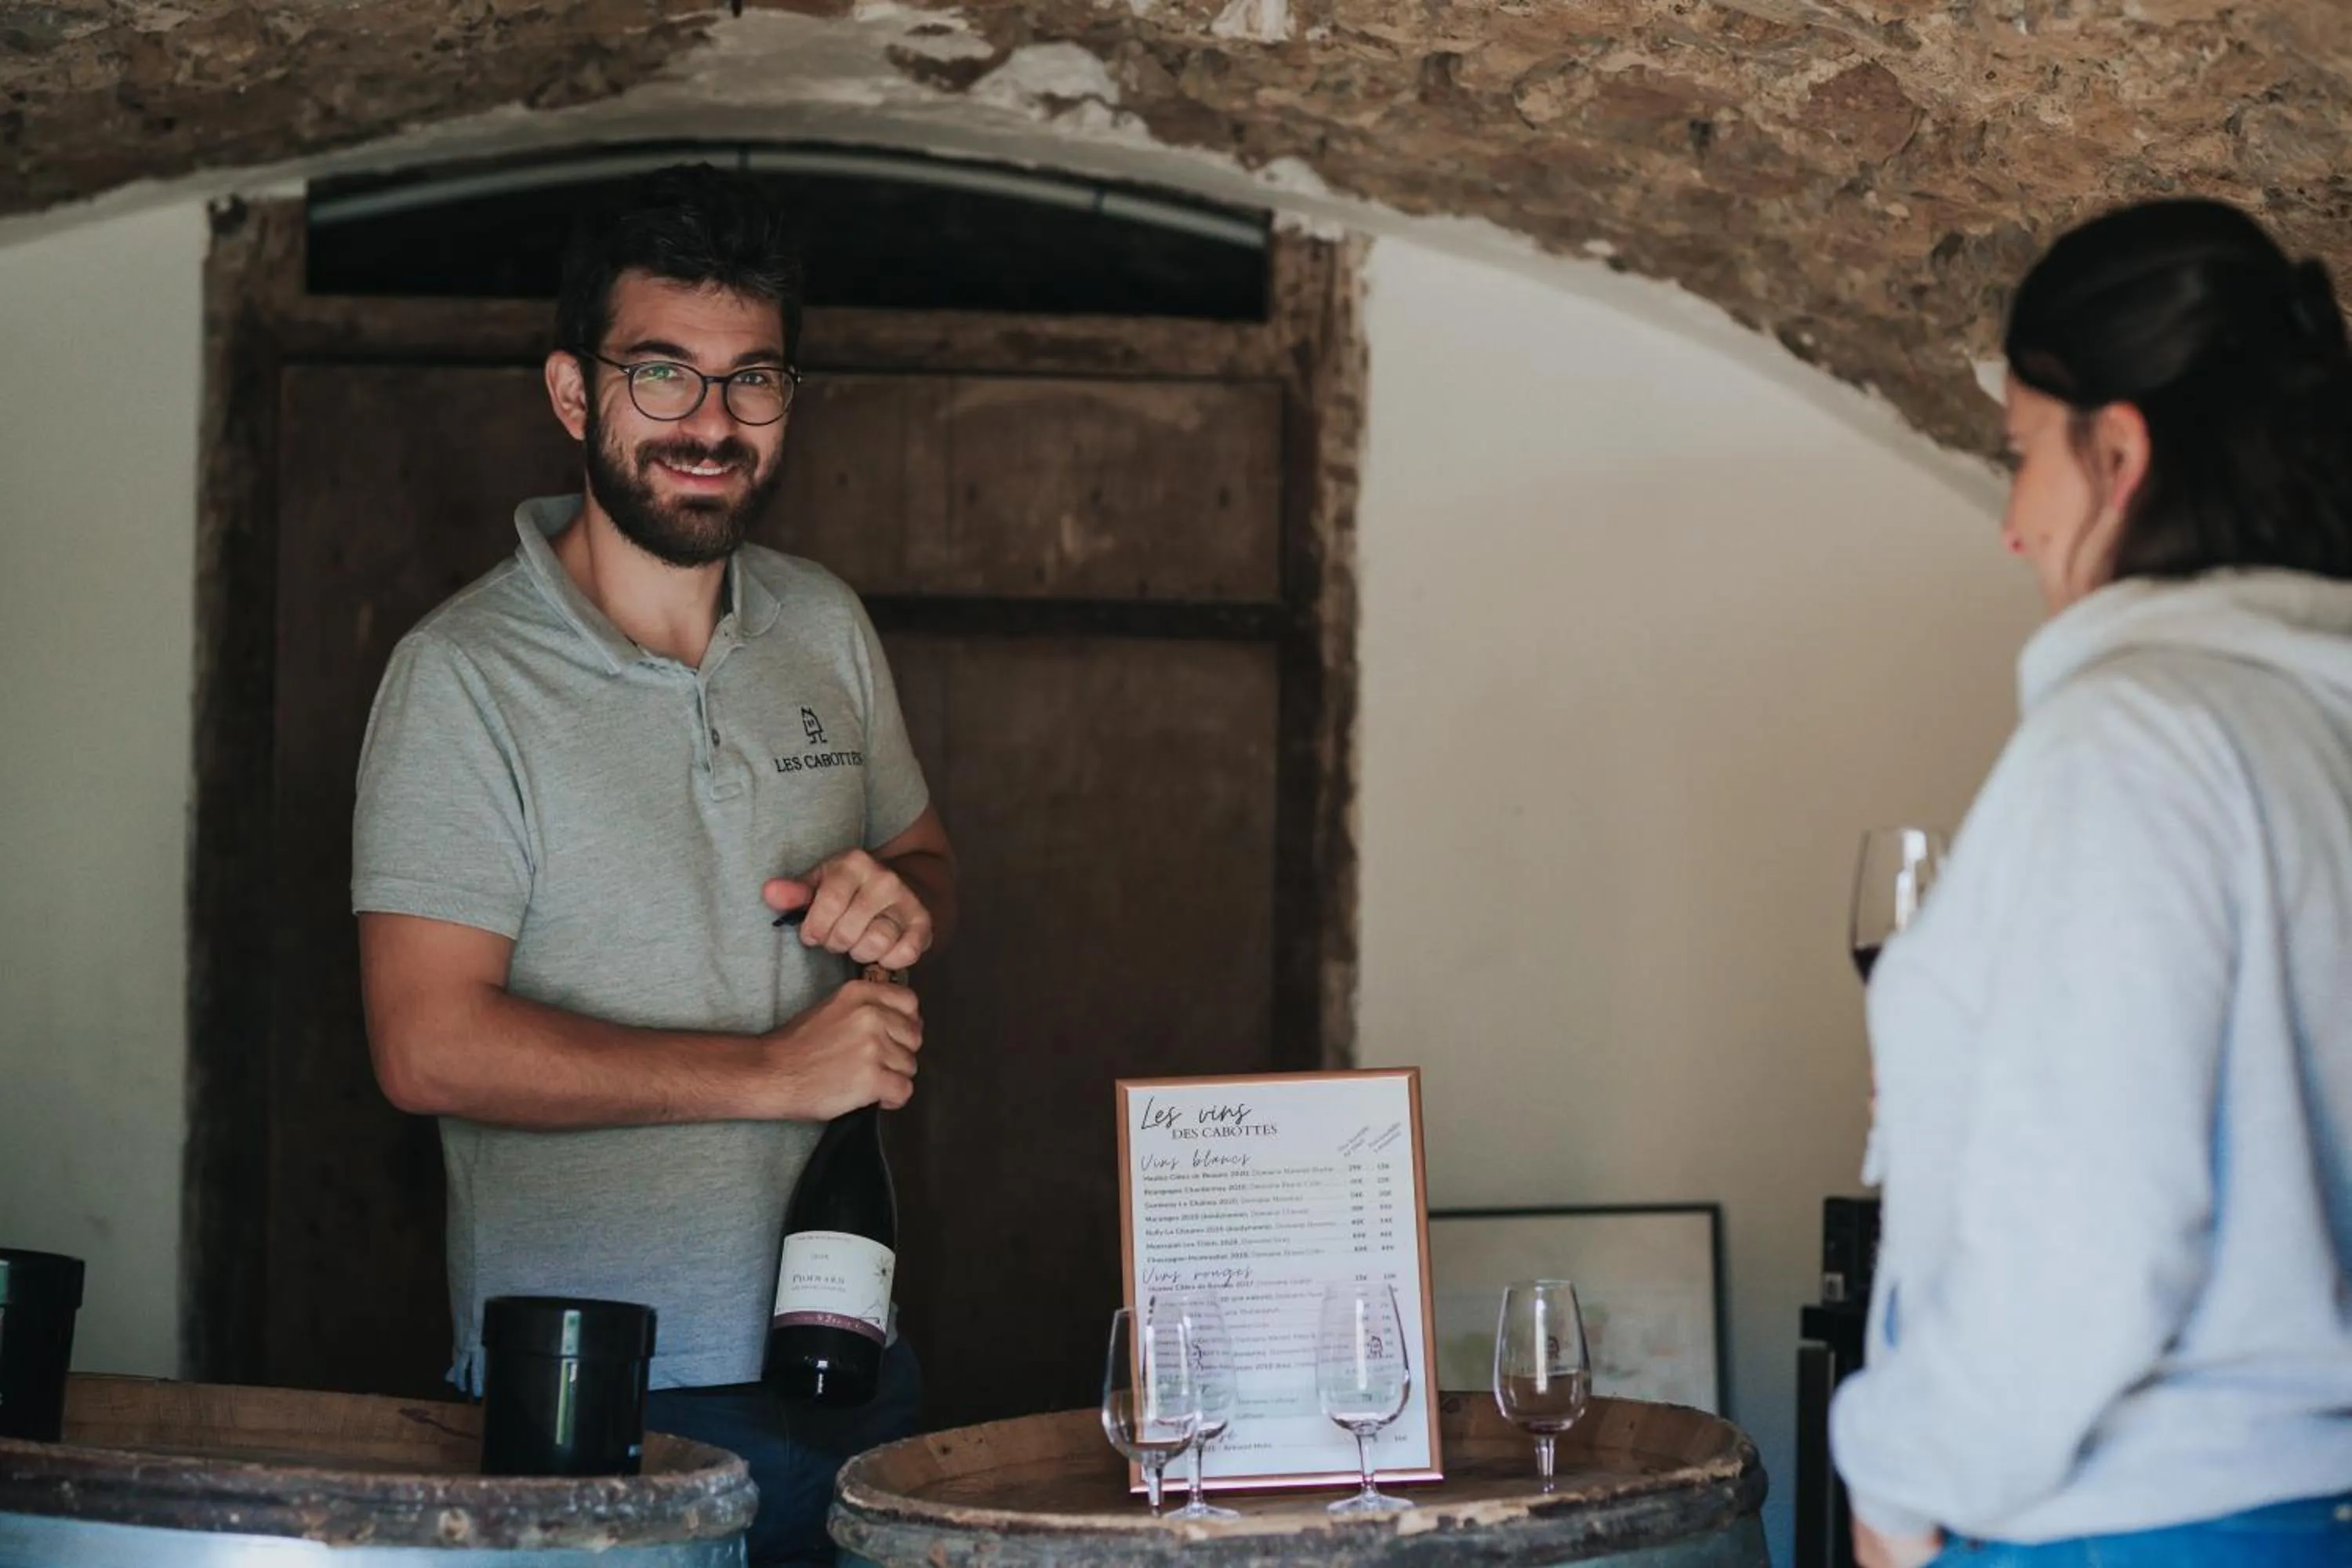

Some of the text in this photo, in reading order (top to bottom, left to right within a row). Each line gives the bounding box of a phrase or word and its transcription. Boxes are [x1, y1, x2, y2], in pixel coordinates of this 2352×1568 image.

[774, 757, 802, 772] LES
[1142, 1096, 1252, 1130] Les vins
[1171, 1124, 1278, 1139] DES CABOTTES
[1141, 1149, 1254, 1171] Vins blancs
[1142, 1265, 1253, 1288] Vins rouges
